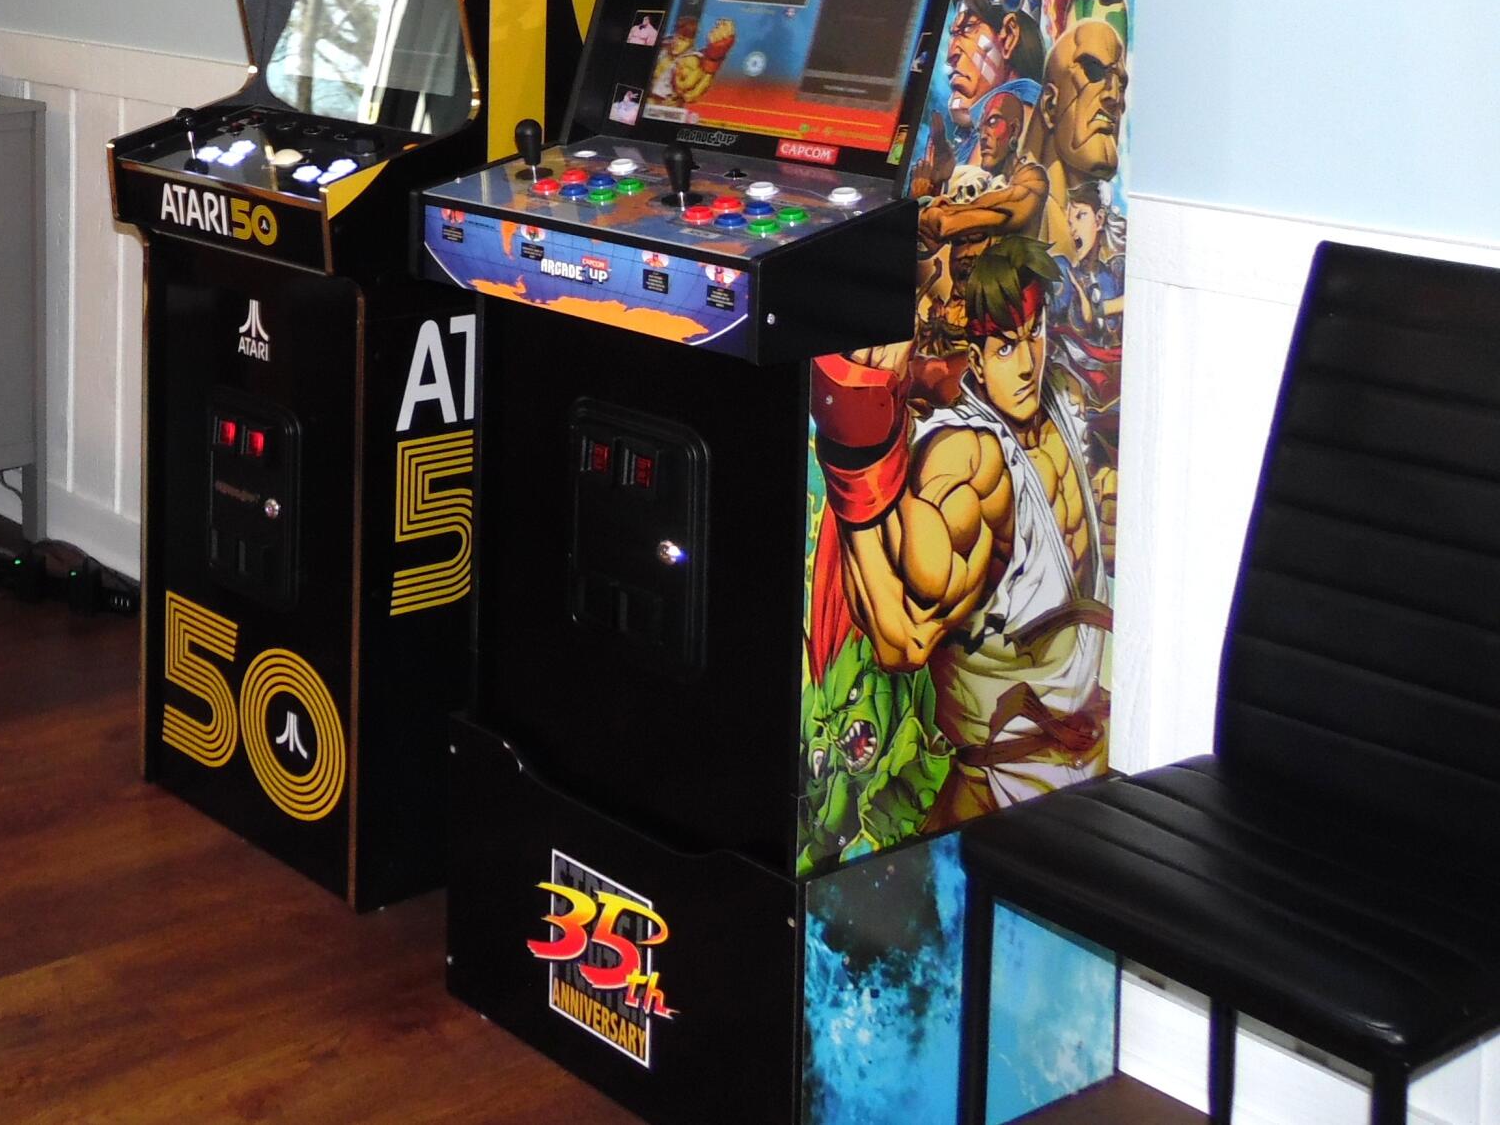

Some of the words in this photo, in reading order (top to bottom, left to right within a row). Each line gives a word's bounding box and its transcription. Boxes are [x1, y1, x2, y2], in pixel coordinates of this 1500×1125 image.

[780, 142, 833, 159] CAPCOM
[160, 182, 228, 236] ATARI
[229, 197, 278, 246] 50
[238, 335, 270, 362] ATARI
[161, 589, 347, 822] 50
[551, 976, 647, 1059] ANNIVERSARY
